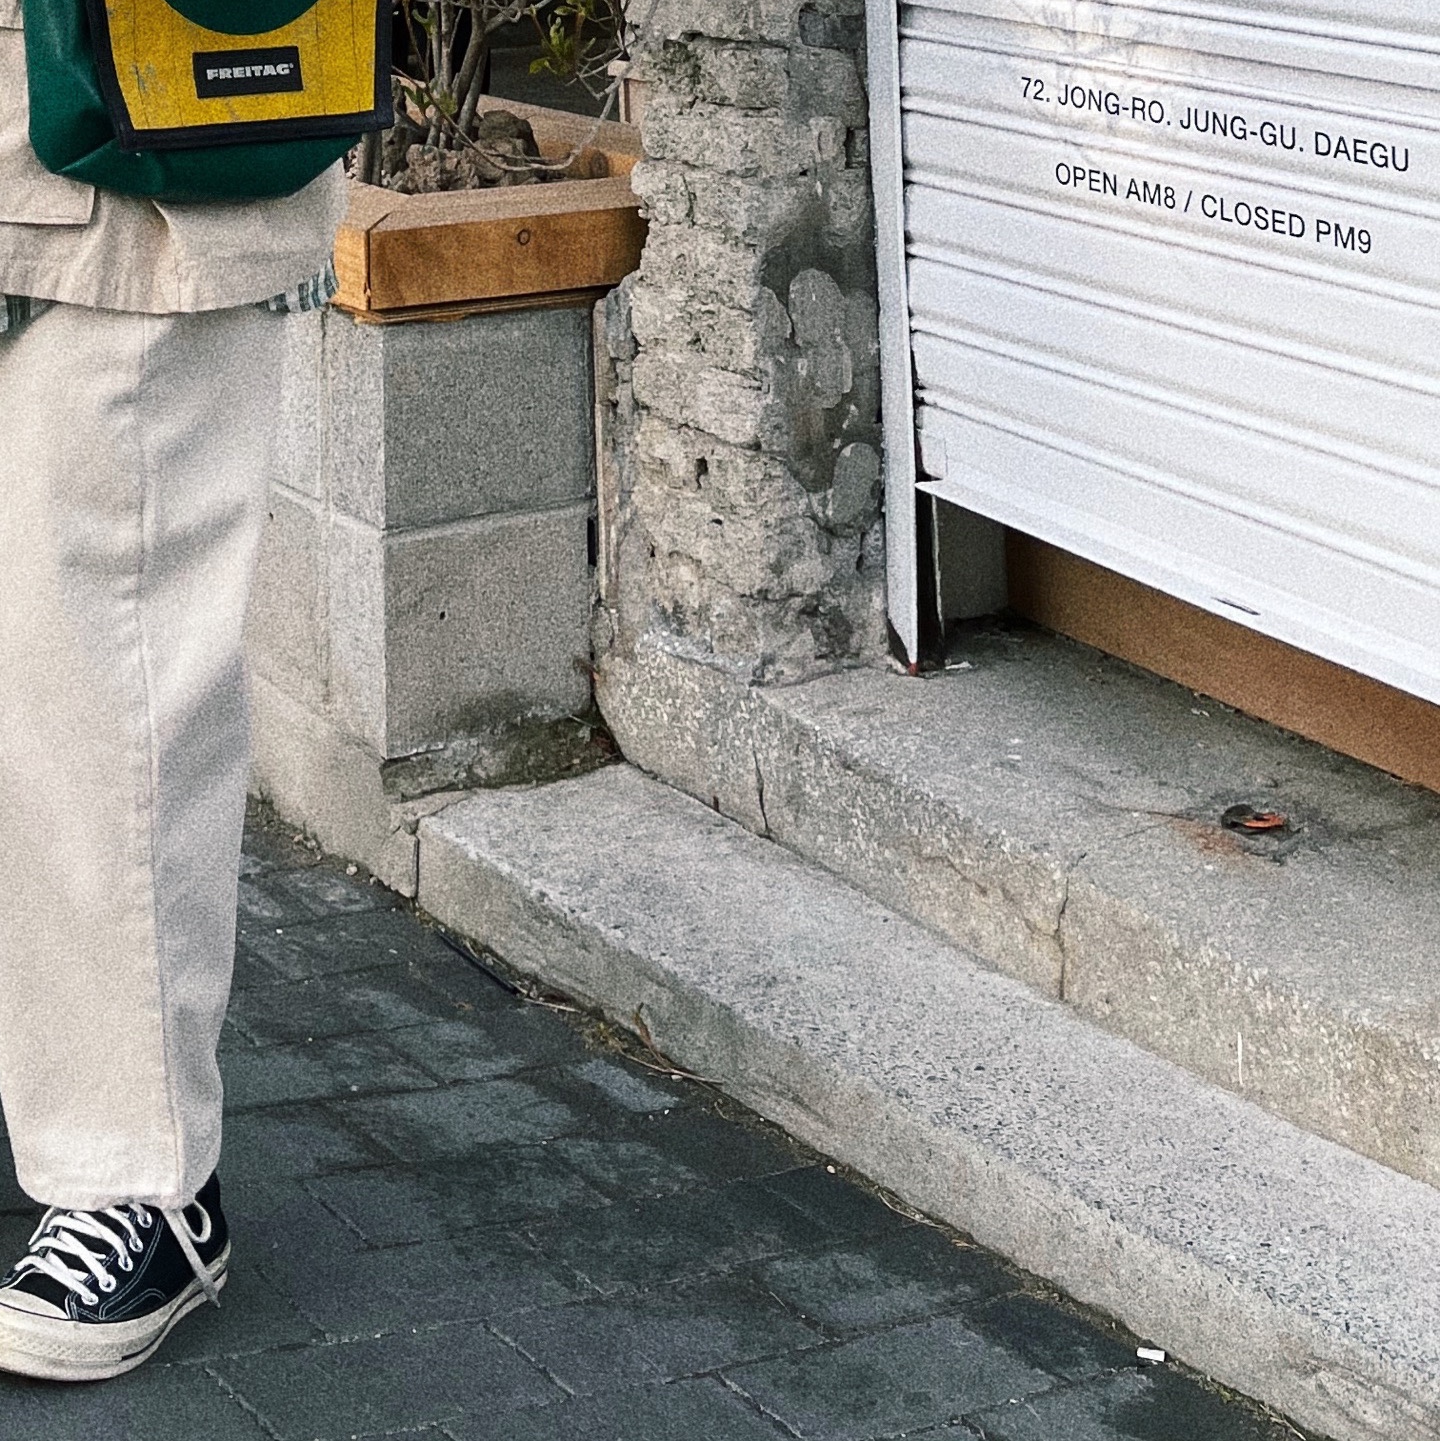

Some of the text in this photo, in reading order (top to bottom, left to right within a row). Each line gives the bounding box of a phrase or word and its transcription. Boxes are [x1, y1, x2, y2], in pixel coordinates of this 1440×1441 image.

[1314, 131, 1410, 172] DAEGU
[1055, 162, 1118, 196] OPEN
[1125, 178, 1177, 210] AM8
[1201, 194, 1305, 239] CLOSED
[1315, 219, 1373, 254] PM9
